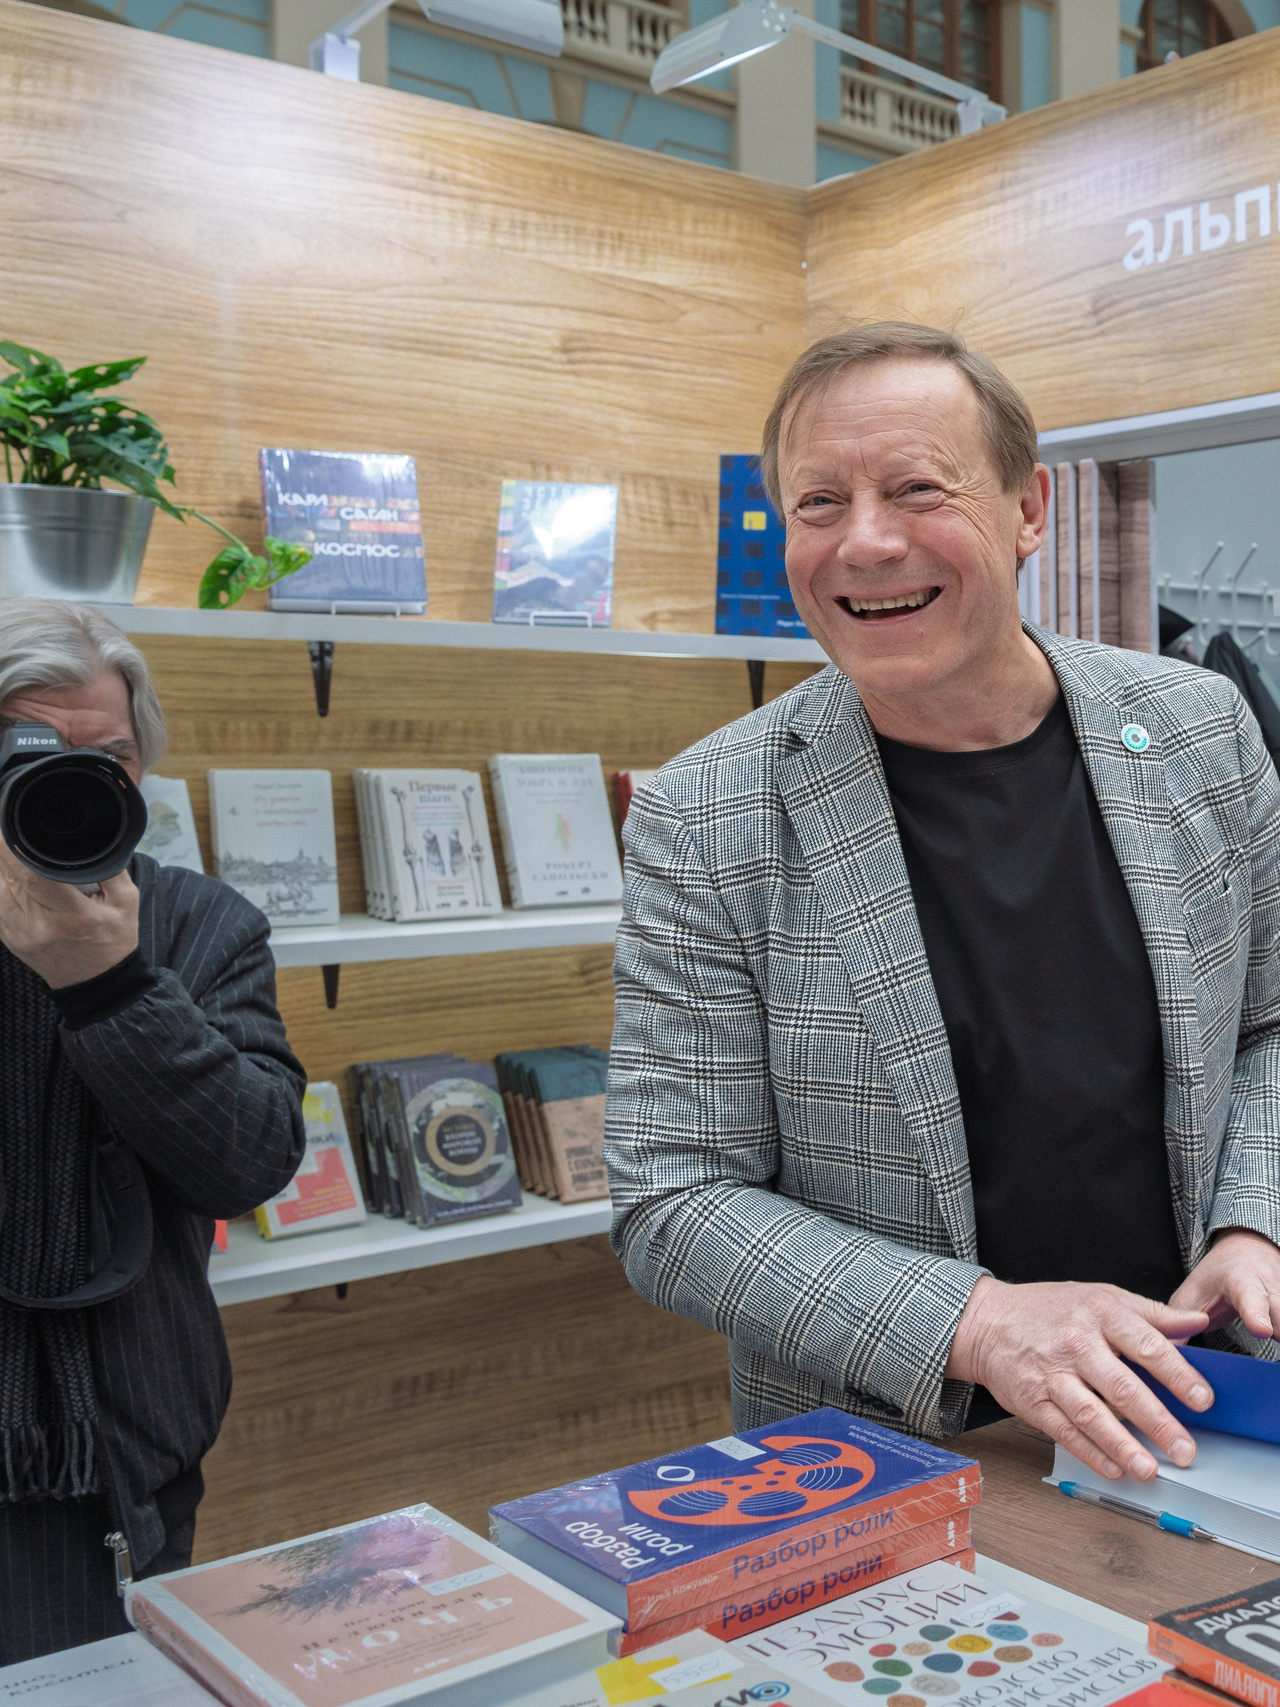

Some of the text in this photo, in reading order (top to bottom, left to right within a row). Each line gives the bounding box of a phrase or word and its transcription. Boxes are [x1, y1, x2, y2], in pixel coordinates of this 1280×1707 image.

[278, 493, 329, 507] КАРЛ
[340, 507, 399, 521] САГАН
[314, 542, 400, 558] КОСМОС
[17, 737, 57, 746] Nikon
[564, 1519, 657, 1570] Разбор
[617, 1521, 694, 1558] роли
[732, 1507, 895, 1580] Разбор роли
[673, 1574, 719, 1596] Кожухарь
[721, 1553, 884, 1630] Разбор роли
[746, 1575, 945, 1657] ТЕЗАУРУС
[785, 1581, 988, 1668] ЭМОЦИЙ
[1213, 1659, 1278, 1707] ДИАЛОГИ
